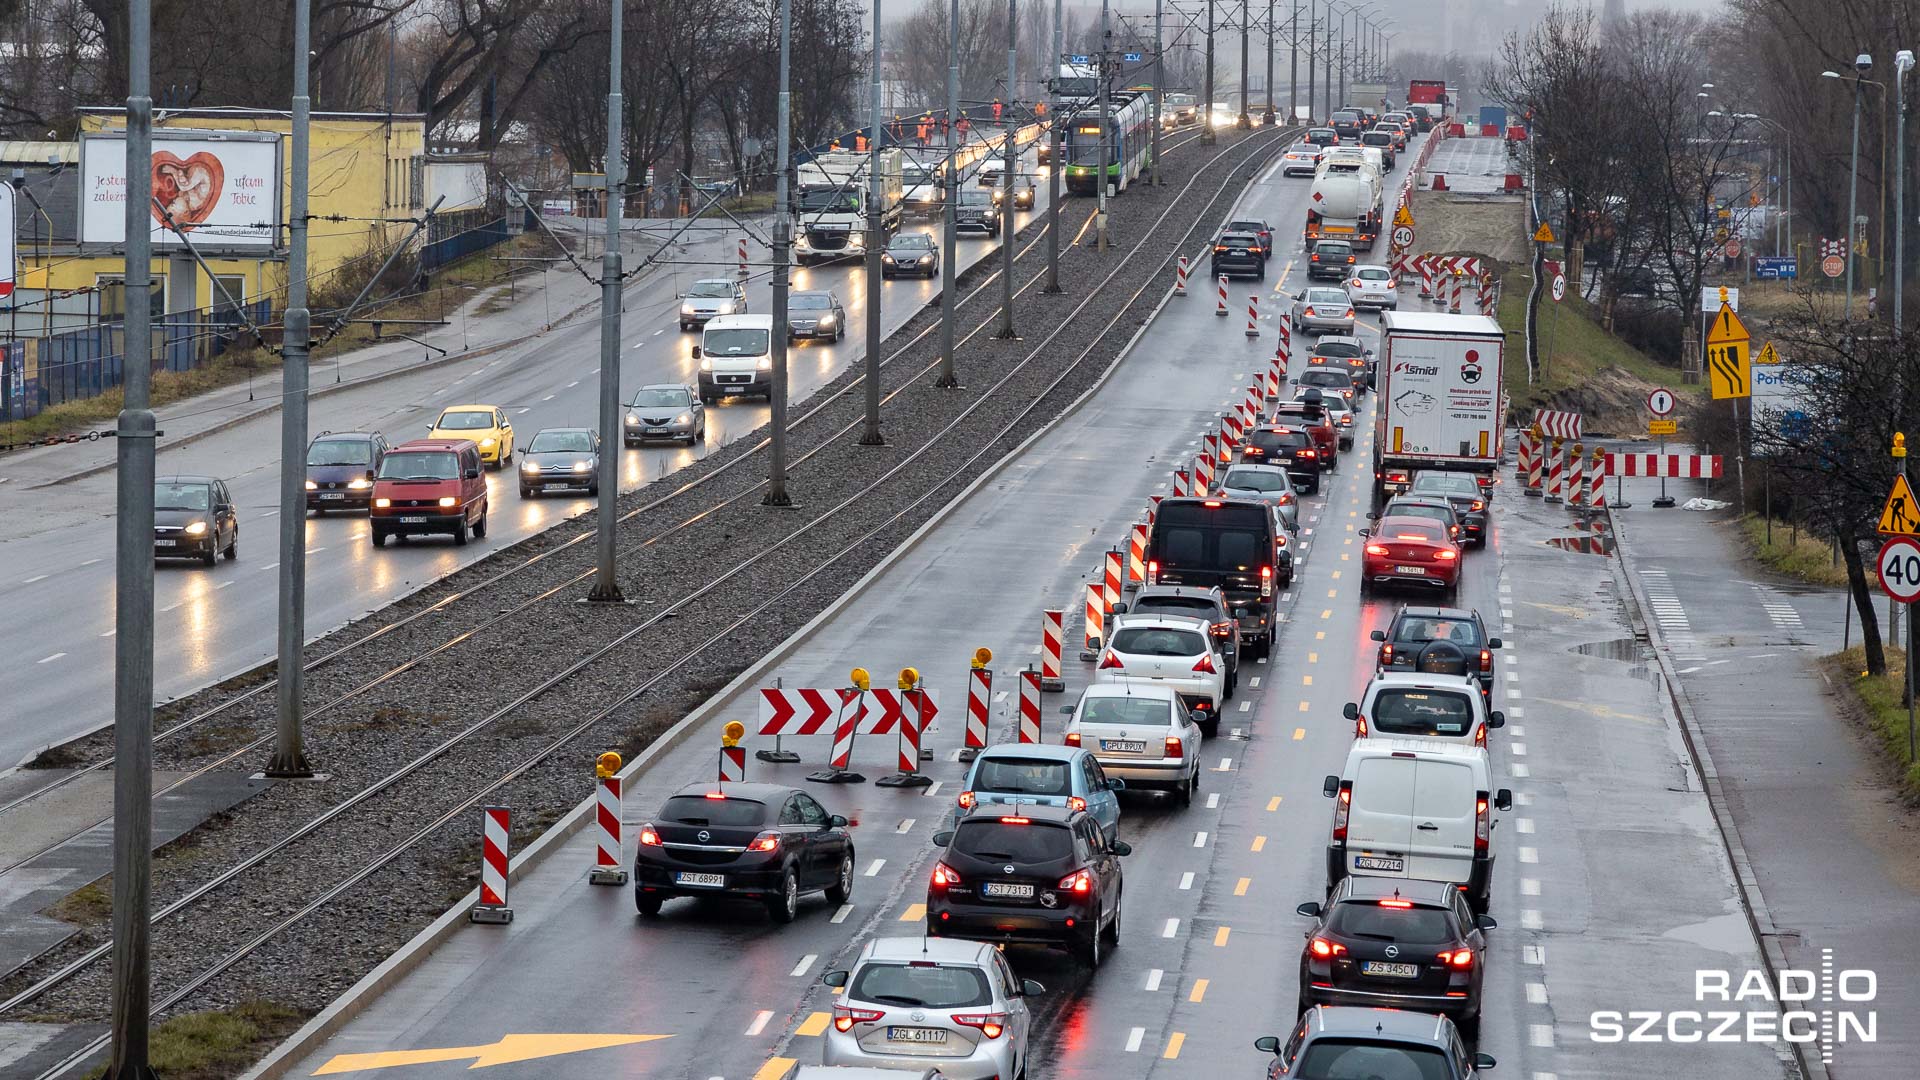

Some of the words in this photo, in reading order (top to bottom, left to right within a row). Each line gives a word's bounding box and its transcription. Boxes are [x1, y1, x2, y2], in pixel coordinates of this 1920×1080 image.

[1395, 231, 1412, 242] 40
[1825, 262, 1842, 270] STOP
[1553, 279, 1564, 296] 40
[1885, 554, 1920, 586] 40
[1106, 742, 1123, 750] GPU
[1125, 742, 1143, 751] 89UX
[1360, 859, 1374, 868] ZGL
[1377, 860, 1401, 869] 77214
[681, 872, 696, 882] ZST
[698, 874, 724, 885] 68991
[988, 884, 1003, 894] ZST
[1006, 885, 1033, 895] 73131
[1370, 963, 1384, 972] ZS
[1387, 964, 1416, 975] 345CV
[893, 1028, 912, 1040] ZGL
[915, 1029, 945, 1041] 61117
